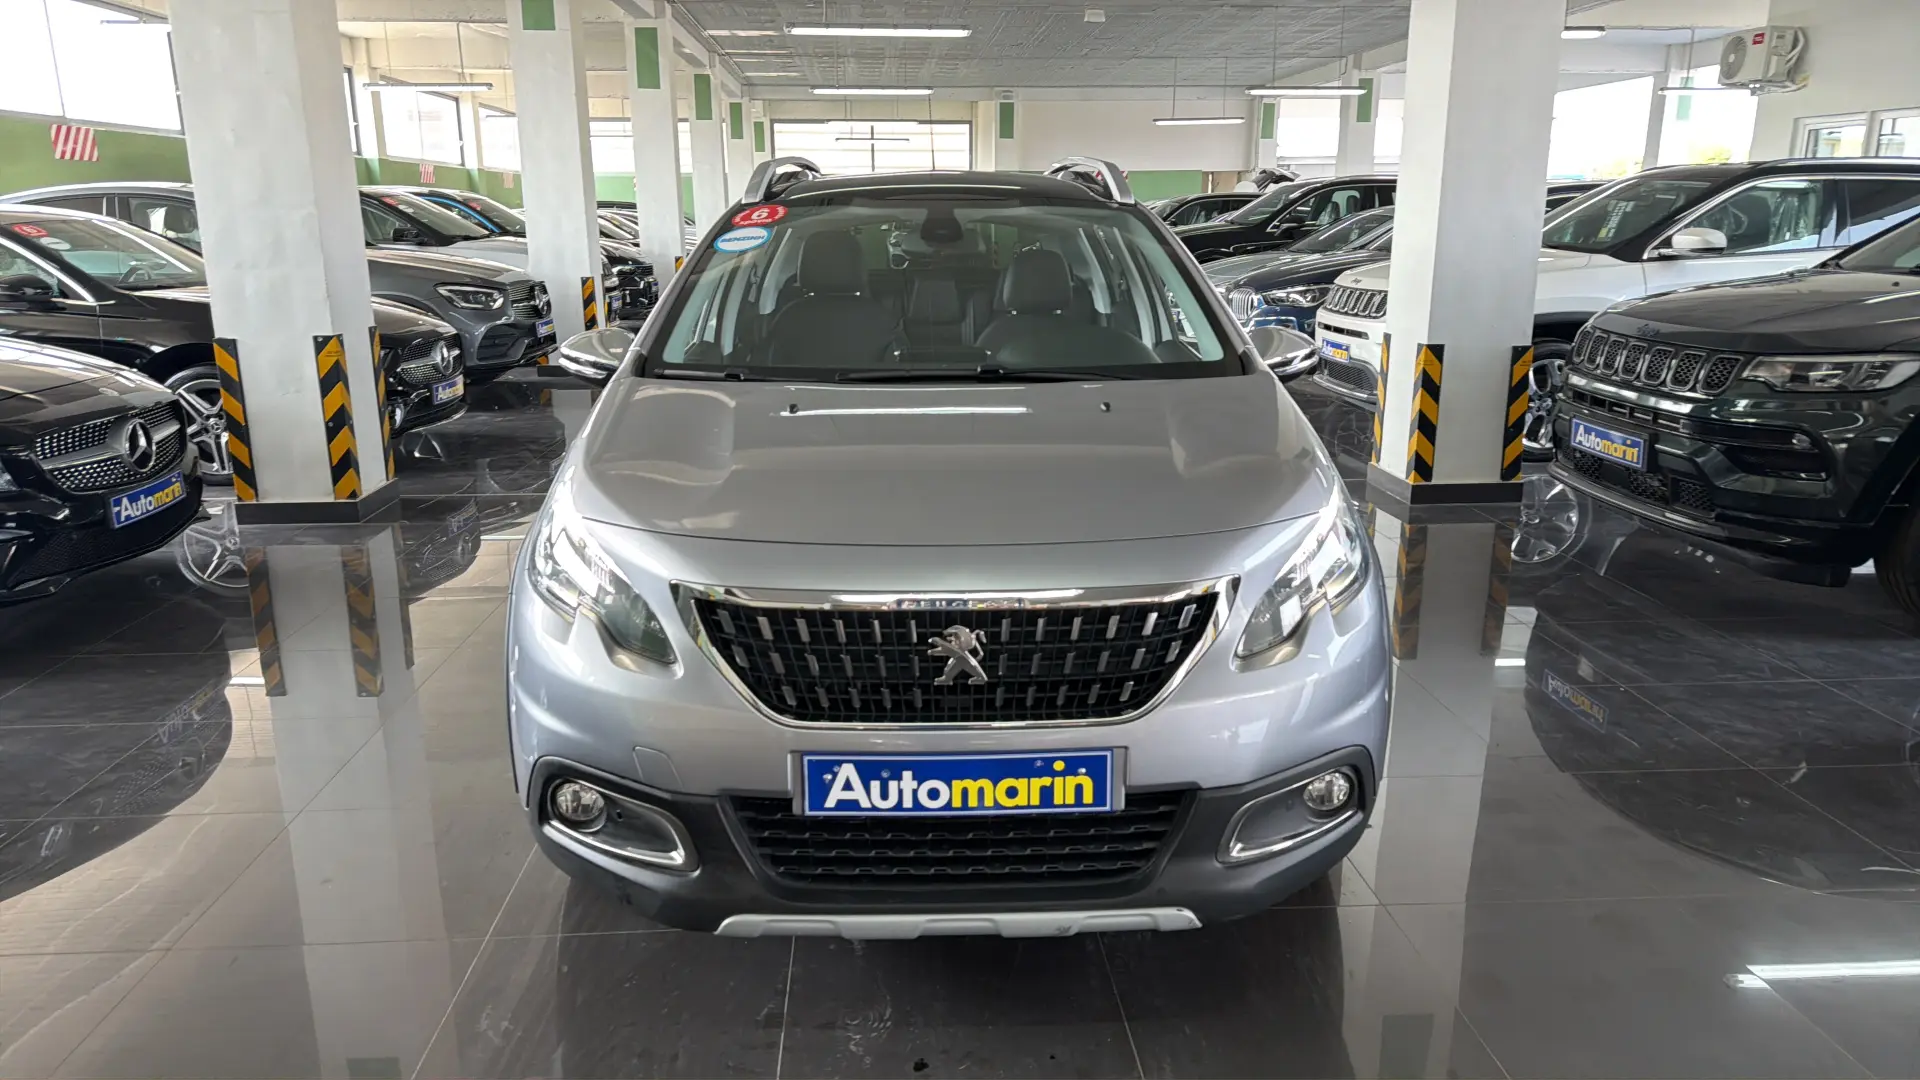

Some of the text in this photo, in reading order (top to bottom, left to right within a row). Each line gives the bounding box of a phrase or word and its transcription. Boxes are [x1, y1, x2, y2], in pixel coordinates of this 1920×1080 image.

[751, 207, 770, 220] 6
[1575, 424, 1639, 463] Automarin
[120, 476, 182, 522] Automarin
[823, 760, 1094, 809] Automarin
